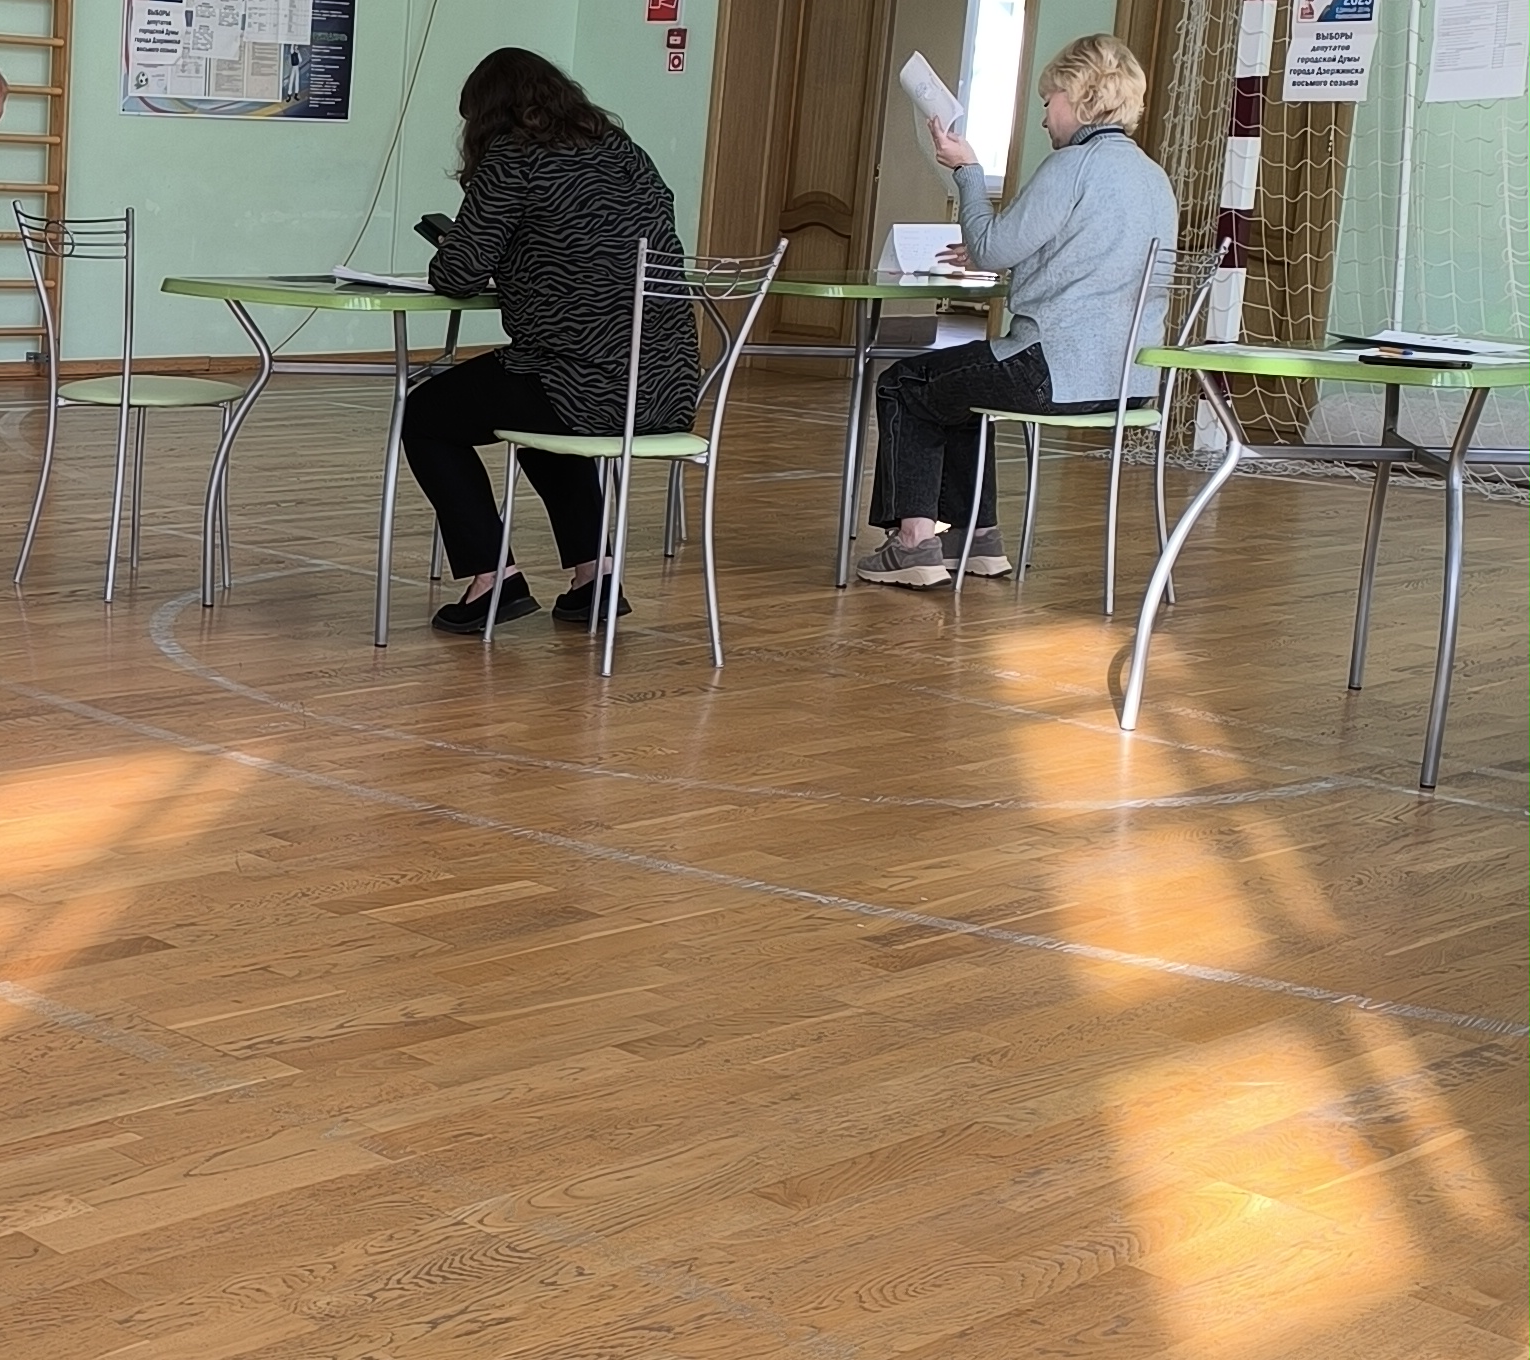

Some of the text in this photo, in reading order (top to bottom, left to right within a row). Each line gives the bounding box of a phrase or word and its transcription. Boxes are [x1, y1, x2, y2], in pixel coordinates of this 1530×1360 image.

[1316, 32, 1353, 40] ВЫБОРЫ
[1310, 44, 1351, 52] депутатов
[1297, 54, 1360, 64] городской Думы
[1290, 67, 1364, 76] города Дзержинска
